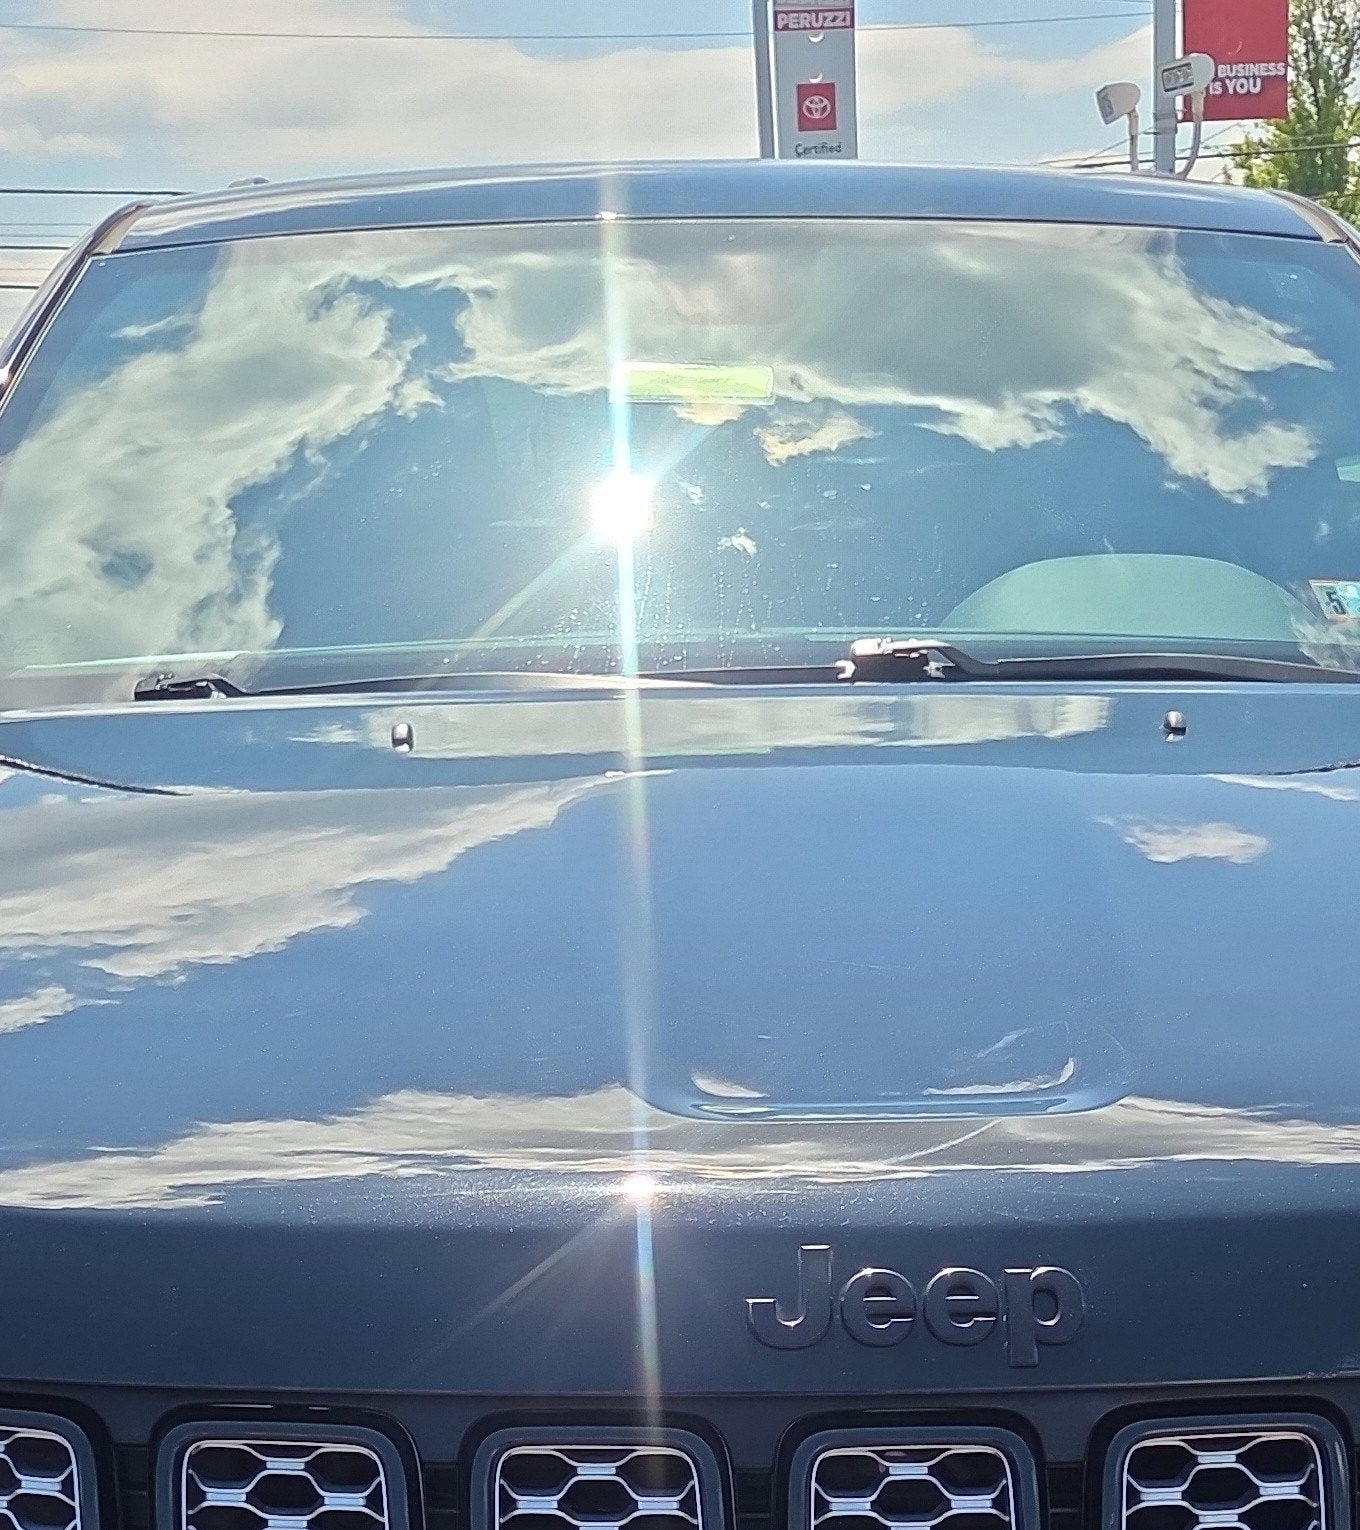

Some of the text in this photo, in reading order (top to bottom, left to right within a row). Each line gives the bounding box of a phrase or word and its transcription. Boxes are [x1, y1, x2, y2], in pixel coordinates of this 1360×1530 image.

[777, 11, 851, 30] PERUZZI
[1217, 62, 1286, 78] BUSINESS
[1225, 77, 1262, 95] YOU
[1325, 590, 1347, 615] 5
[745, 1243, 1086, 1368] Jeep
